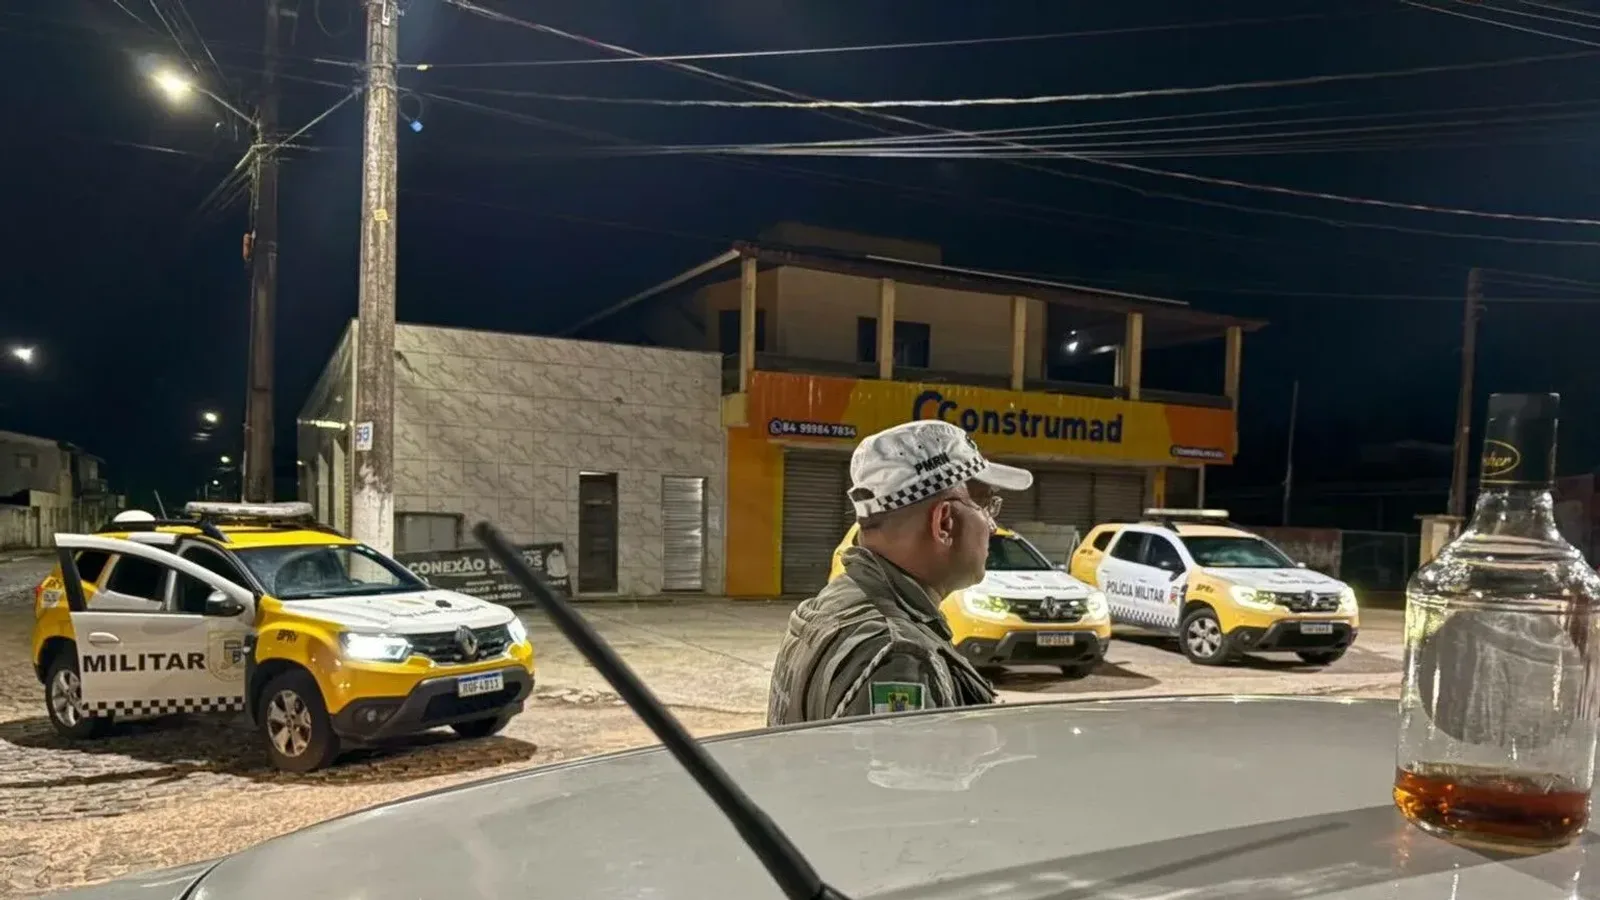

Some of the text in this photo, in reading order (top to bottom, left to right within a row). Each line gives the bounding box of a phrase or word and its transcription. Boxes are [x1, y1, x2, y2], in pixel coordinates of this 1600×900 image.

[408, 557, 486, 574] CONEXÃO
[1135, 585, 1165, 602] MILITAR
[83, 653, 205, 673] MILITAR
